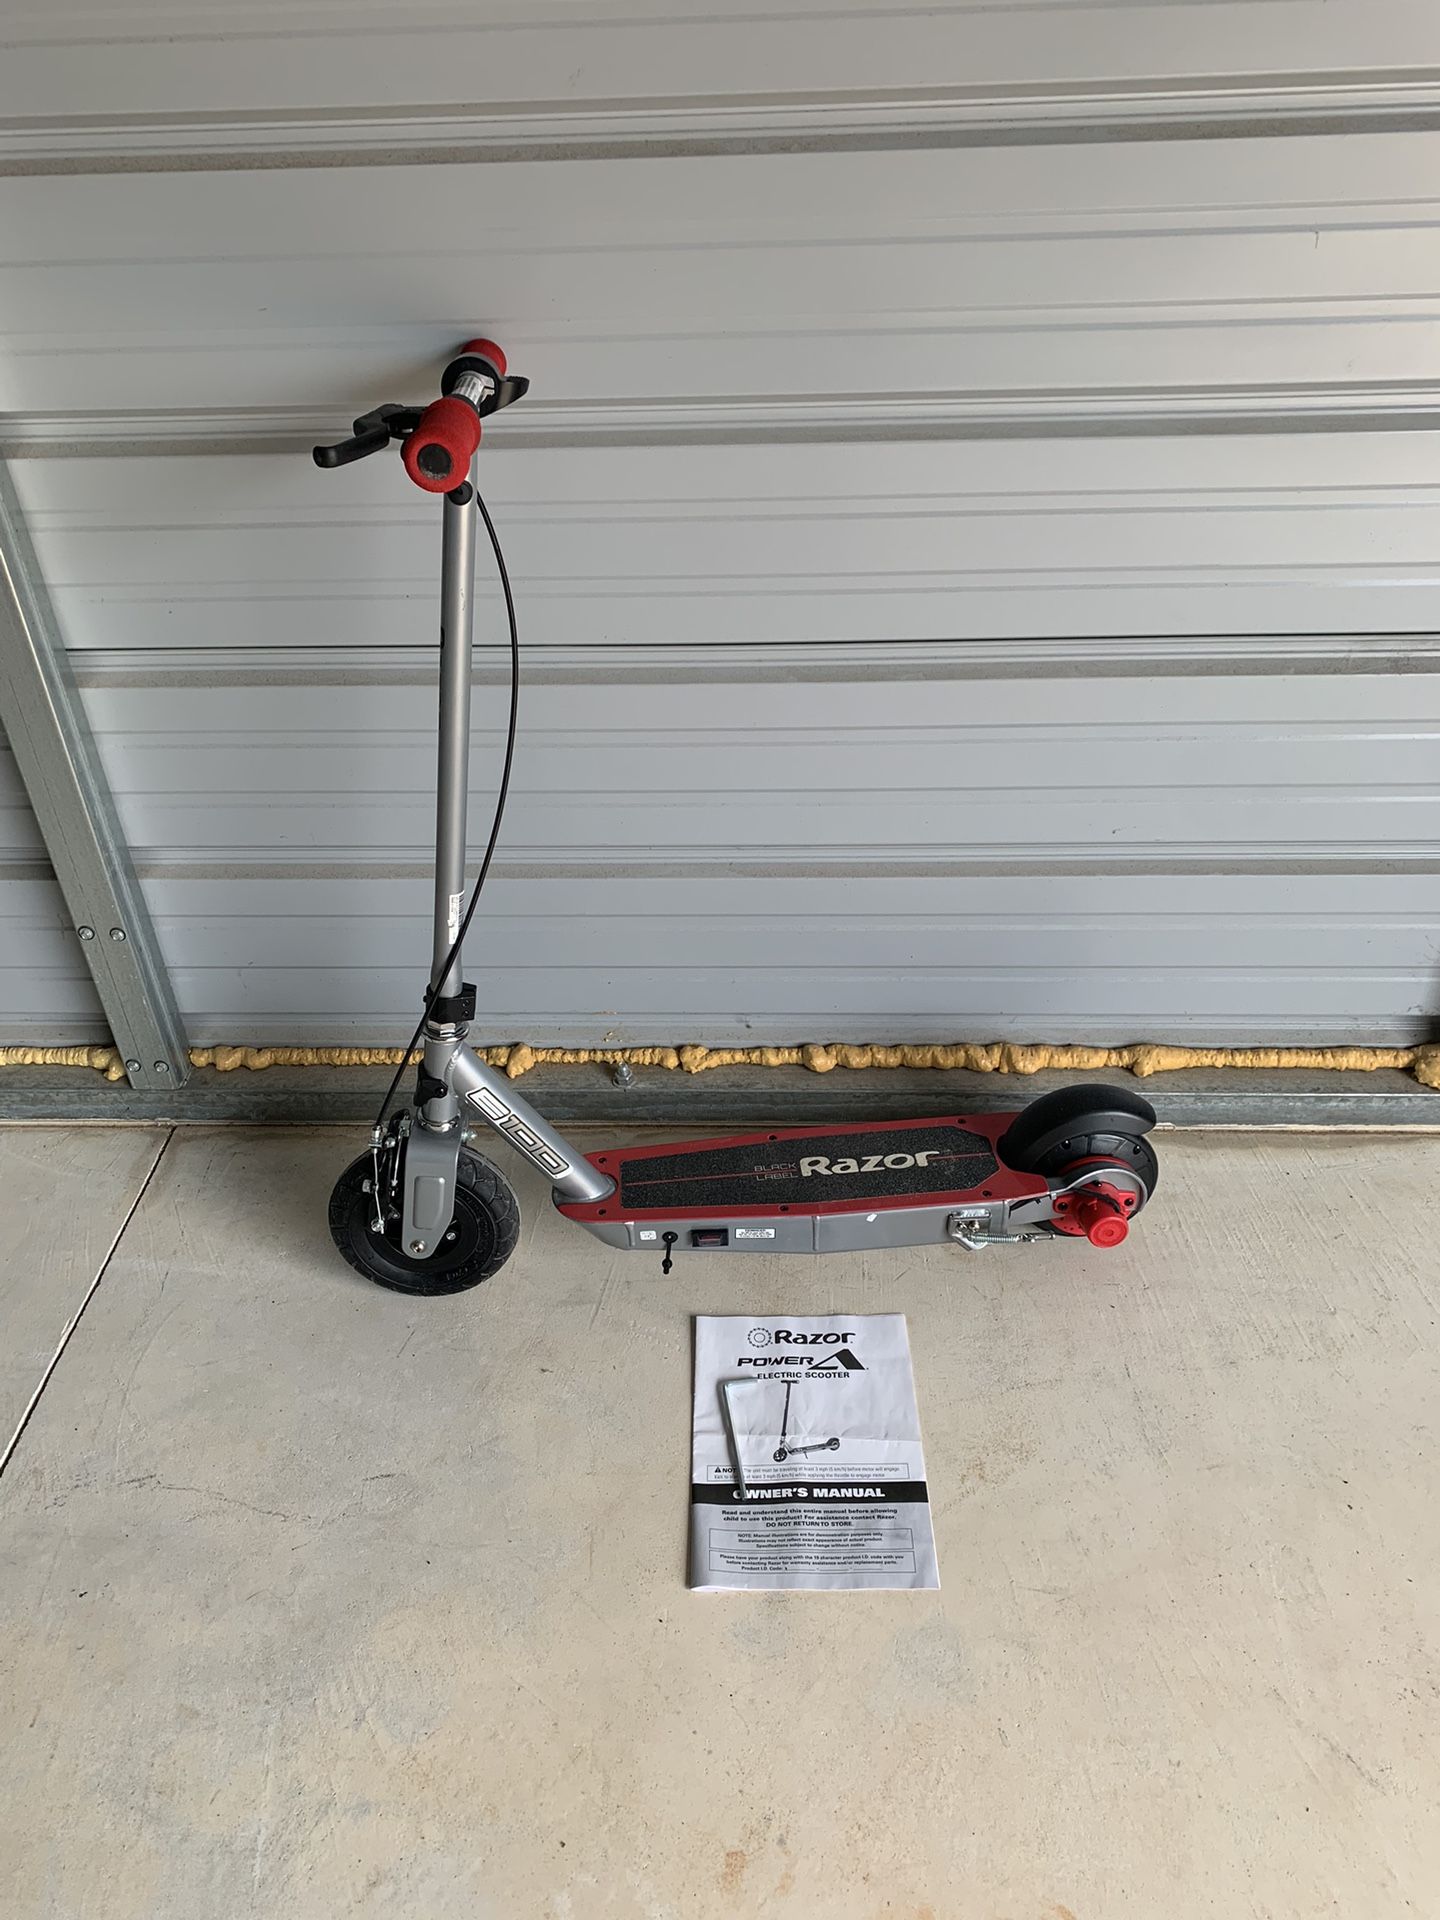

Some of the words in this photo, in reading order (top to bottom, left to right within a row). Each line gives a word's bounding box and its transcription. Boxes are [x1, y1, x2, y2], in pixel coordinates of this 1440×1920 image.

[467, 1087, 570, 1175] E100
[754, 1163, 796, 1171] BLACK
[800, 1151, 940, 1177] Razor
[756, 1172, 798, 1181] LABEL
[774, 1330, 856, 1345] Razor
[737, 1356, 814, 1367] POWER
[733, 1488, 808, 1499] OWNER'S
[813, 1487, 885, 1498] MANUAL
